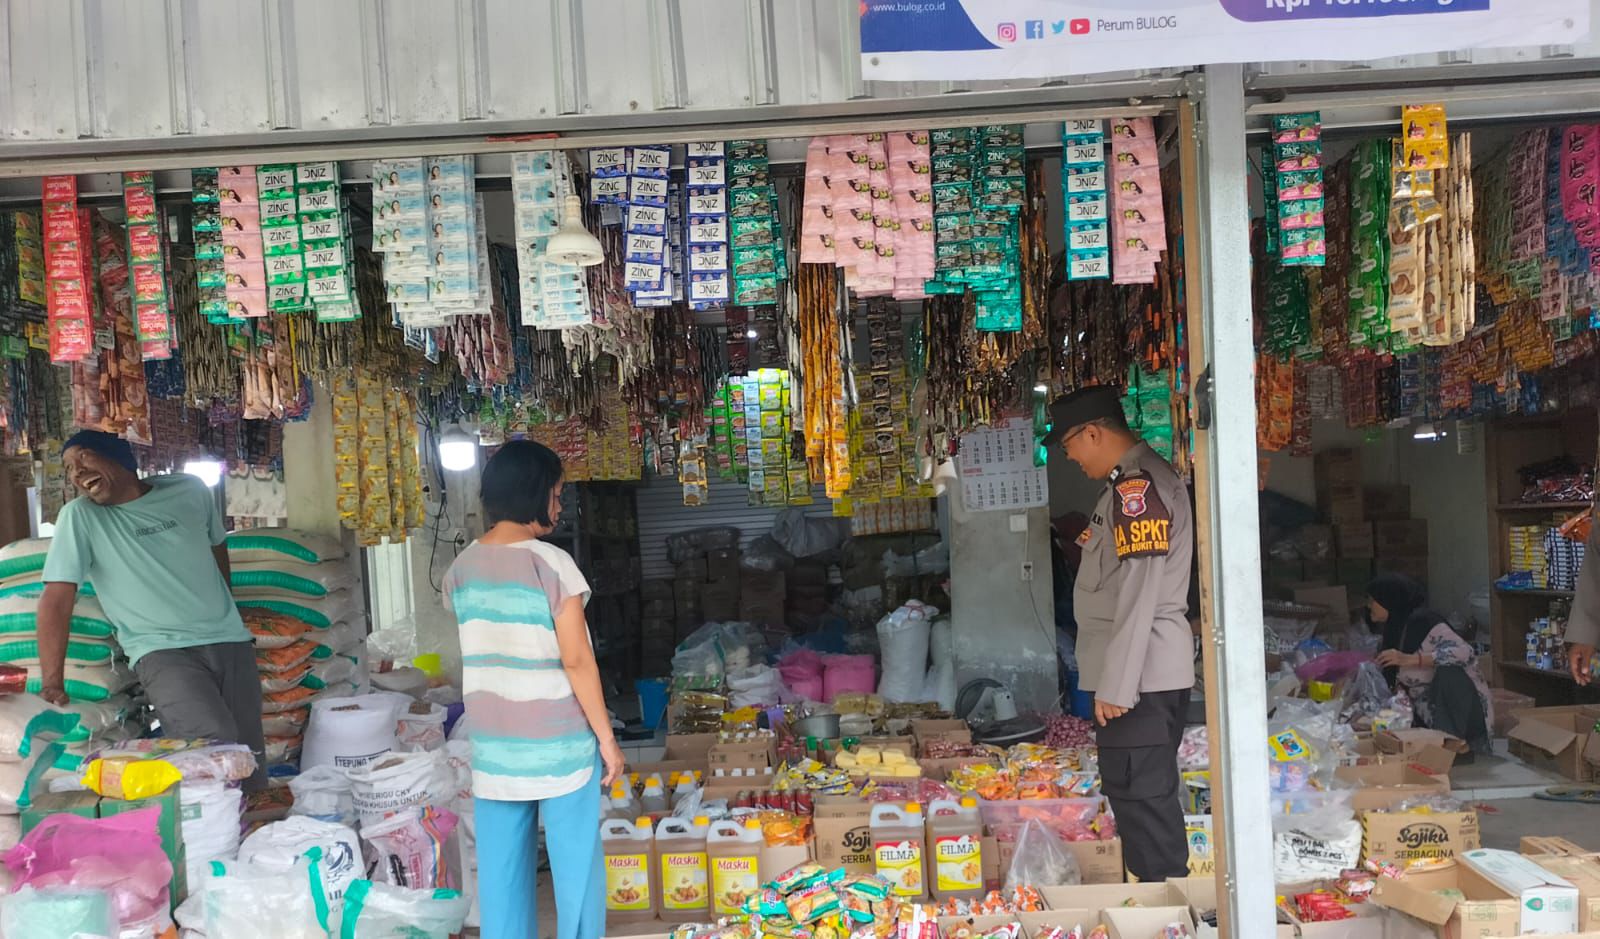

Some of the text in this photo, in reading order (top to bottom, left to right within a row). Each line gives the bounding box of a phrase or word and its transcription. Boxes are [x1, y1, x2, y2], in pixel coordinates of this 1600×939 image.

[873, 2, 945, 13] www.bulog.co.id
[1097, 16, 1177, 32] Perum BULOG
[597, 152, 619, 163] ZINC
[639, 151, 662, 164] ZINC
[1074, 148, 1096, 158] ZINC
[304, 168, 326, 178] ZINC
[696, 171, 717, 180] ZINC
[265, 175, 287, 186] ZINC
[599, 180, 620, 191] ZINC
[1075, 176, 1098, 187] ZINC
[637, 181, 660, 192] ZINC
[306, 195, 328, 206] ZINC
[697, 199, 718, 208] ZINC
[267, 203, 289, 213] ZINC
[1077, 205, 1098, 216] ZINC
[635, 209, 657, 221] ZINC
[309, 224, 331, 235] ZINC
[699, 227, 719, 237] ZINC
[270, 231, 292, 241] ZINC
[1078, 234, 1100, 244] ZINC
[633, 238, 655, 249] ZINC
[312, 252, 334, 263] ZINC
[699, 256, 719, 265] ZINC
[273, 259, 295, 270] ZINC
[1079, 262, 1100, 272] ZINC
[631, 267, 653, 277] ZINC
[275, 286, 297, 296] ZINC
[315, 281, 337, 291] ZINC
[700, 284, 720, 294] ZINC
[1130, 519, 1169, 542] SPKT
[400, 790, 429, 805] UNTUK
[841, 831, 871, 853] Saji
[1397, 826, 1449, 849] Sajiku
[940, 843, 976, 855] FILMA
[1394, 849, 1454, 860] SERBAGUNA
[668, 855, 700, 865] Masku
[841, 855, 872, 864] SERBA
[880, 850, 916, 861] FILMA
[608, 857, 640, 867] Masku
[717, 860, 750, 870] Masku
